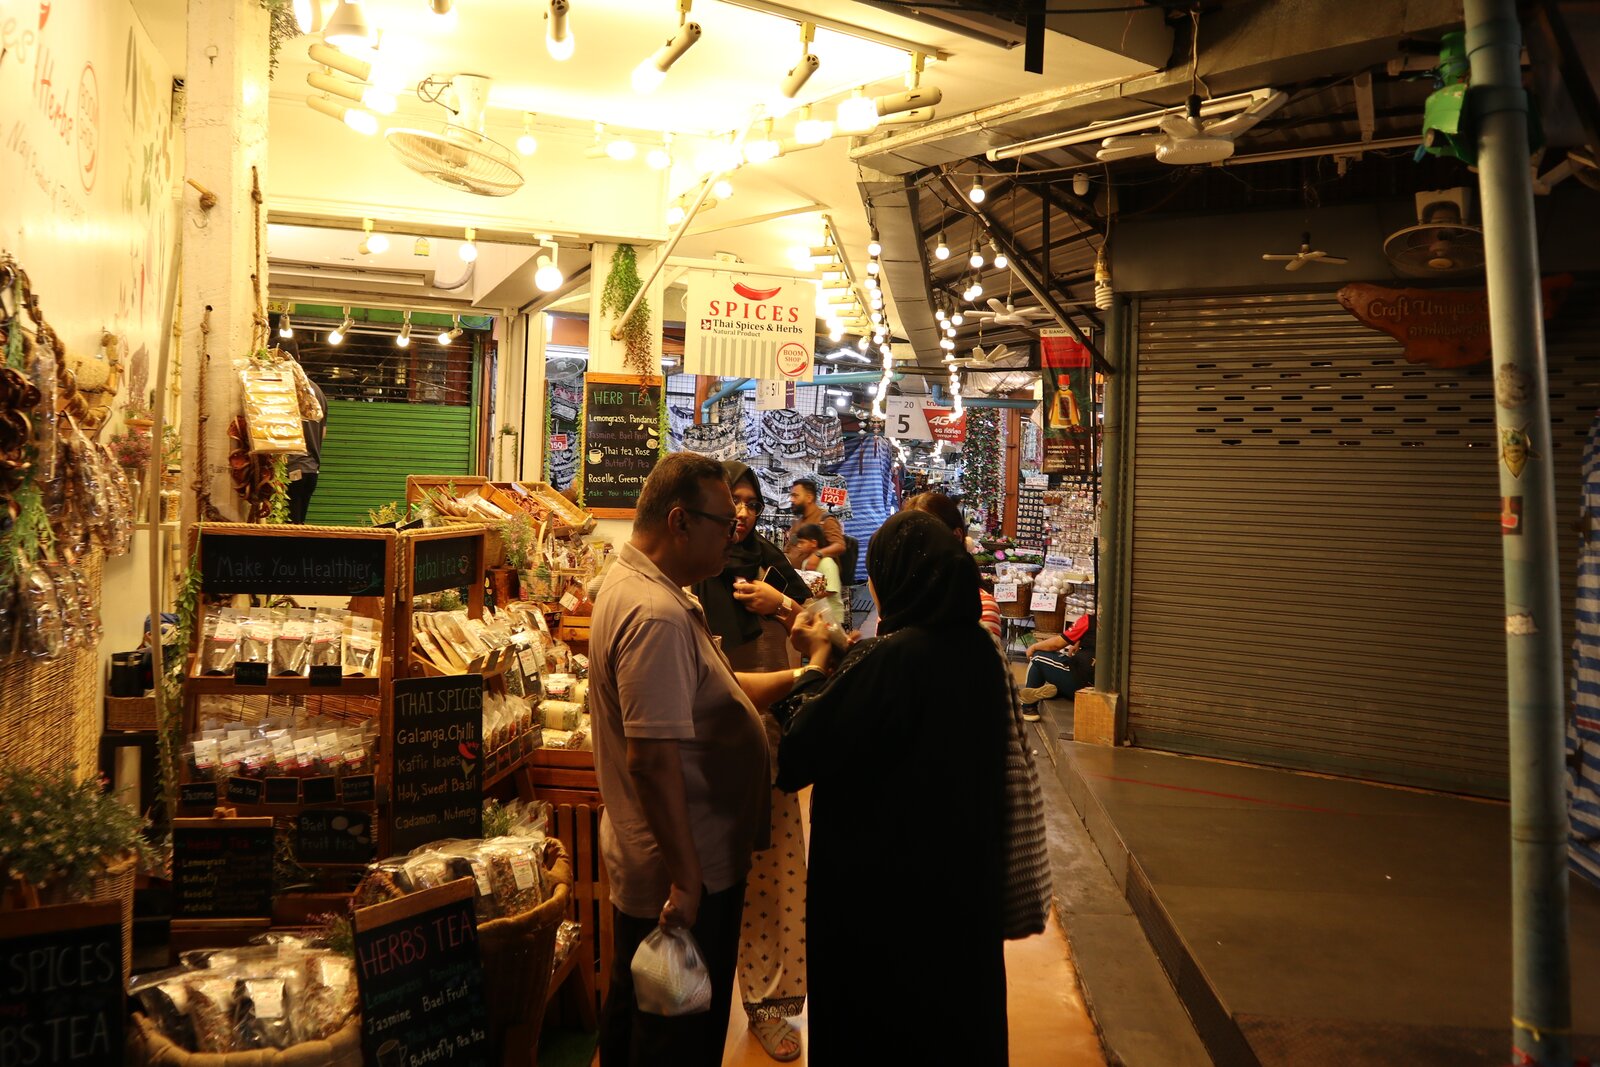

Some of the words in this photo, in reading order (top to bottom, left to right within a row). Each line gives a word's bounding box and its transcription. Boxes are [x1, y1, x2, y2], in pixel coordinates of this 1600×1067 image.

[709, 300, 799, 323] SPICES
[1369, 297, 1410, 322] Craft
[713, 319, 734, 329] Thai
[736, 320, 765, 333] Spices
[767, 324, 774, 332] &
[776, 324, 803, 334] Herbs
[713, 328, 736, 336] Natural
[737, 330, 761, 338] Product
[783, 349, 804, 357] BOOM
[593, 391, 623, 405] HERB
[630, 392, 652, 406] TEA
[904, 401, 914, 409] 20
[589, 414, 627, 427] Lemongrass,
[630, 414, 658, 424] Pandanus
[897, 414, 910, 434] 5
[603, 446, 619, 455] Thai
[621, 446, 634, 457] tea,
[635, 447, 650, 456] Rose
[604, 458, 634, 471] Butterfly
[637, 459, 650, 469] Pea
[588, 473, 617, 484] Roselle,
[618, 474, 638, 483] Green
[824, 494, 840, 504] 120
[216, 555, 263, 578] Make
[271, 556, 297, 577] You
[302, 555, 371, 580] Healthier
[395, 690, 434, 716] THAI
[437, 686, 482, 713] SPICES
[397, 727, 448, 749] Galanga,
[448, 721, 475, 742] Chilli
[398, 754, 429, 775] Kaffir
[433, 755, 461, 769] leaves
[397, 784, 420, 803] Holy,
[421, 778, 448, 797] Sweet
[451, 775, 476, 792] Basil
[444, 806, 477, 825] Nutmeg
[358, 925, 427, 980] HERBS
[432, 910, 475, 952] TEA
[7, 941, 116, 994] SPICES
[367, 1008, 412, 1036] Jasmine
[421, 990, 444, 1013] Bael
[446, 978, 470, 1003] Fruit
[43, 1010, 110, 1063] TEA
[409, 1037, 454, 1067] Butterfly
[456, 1031, 470, 1048] Pea
[470, 1027, 486, 1042] tea
